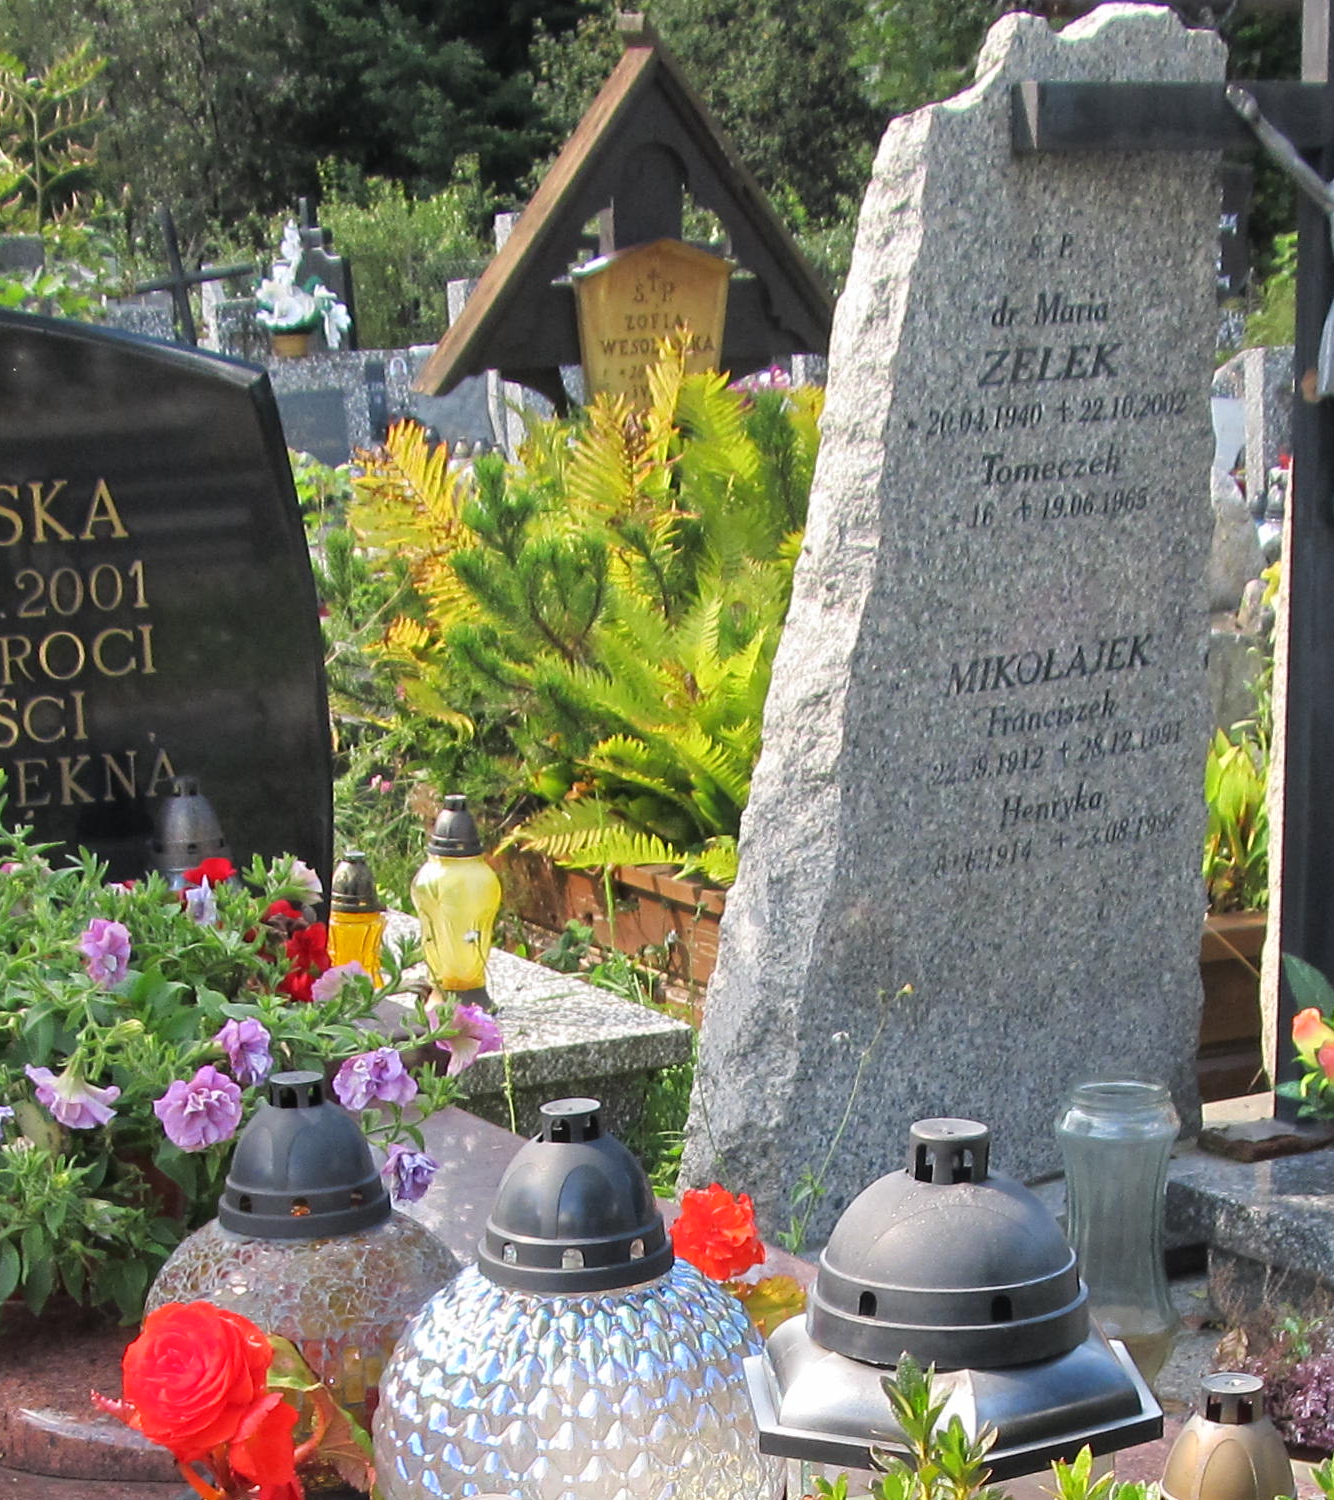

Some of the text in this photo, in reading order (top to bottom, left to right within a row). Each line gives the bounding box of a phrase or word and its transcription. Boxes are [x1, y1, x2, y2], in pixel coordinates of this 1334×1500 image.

[991, 292, 1109, 327] dr Maria
[976, 342, 1124, 388] ZELEK
[982, 443, 1121, 486] Tomeczek
[987, 690, 1116, 738] Franciszek
[1000, 782, 1103, 831] Henryka
